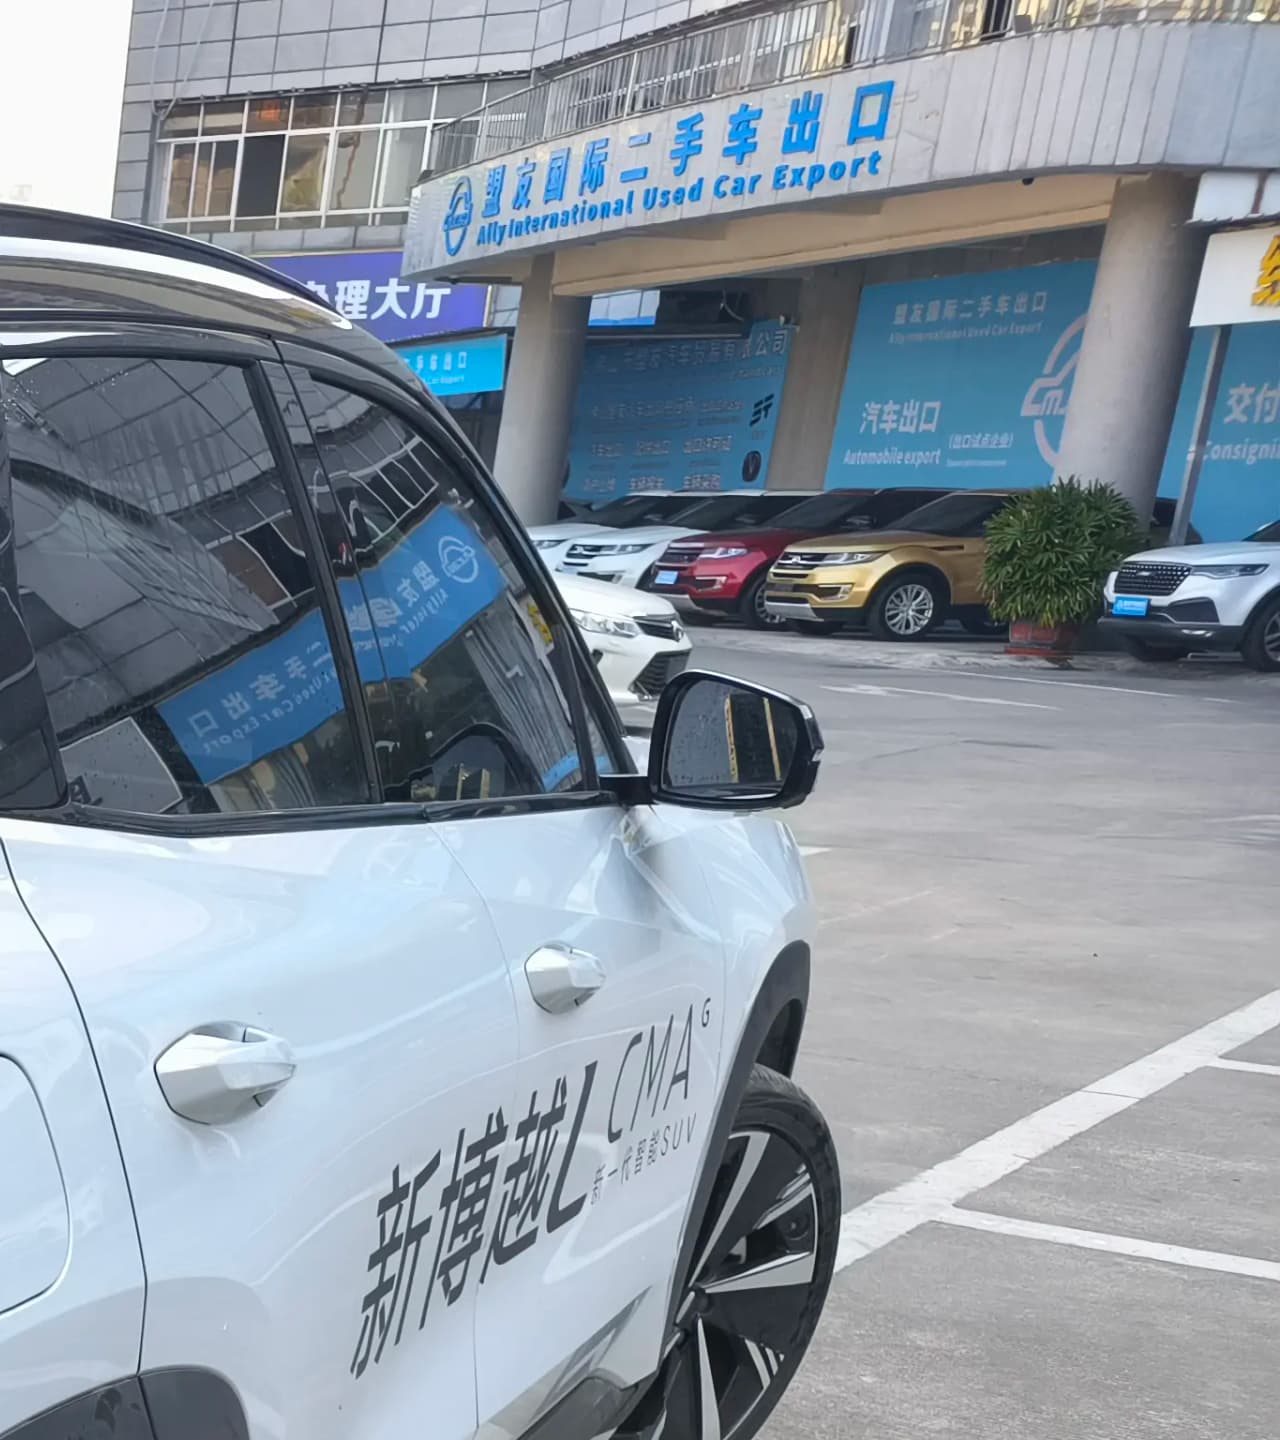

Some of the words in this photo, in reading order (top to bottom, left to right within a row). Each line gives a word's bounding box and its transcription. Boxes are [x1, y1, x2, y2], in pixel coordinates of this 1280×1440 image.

[481, 80, 895, 219] 盟友国际二手车出口
[477, 221, 507, 246] Ally
[508, 190, 635, 239] International
[643, 177, 705, 210] Used
[713, 173, 762, 199] Car
[772, 150, 882, 191] Export
[860, 399, 941, 434] 汽车出口
[843, 447, 903, 465] Automobile
[904, 448, 941, 468] export
[1203, 438, 1280, 464] onsigni
[608, 1003, 693, 1144] CMA
